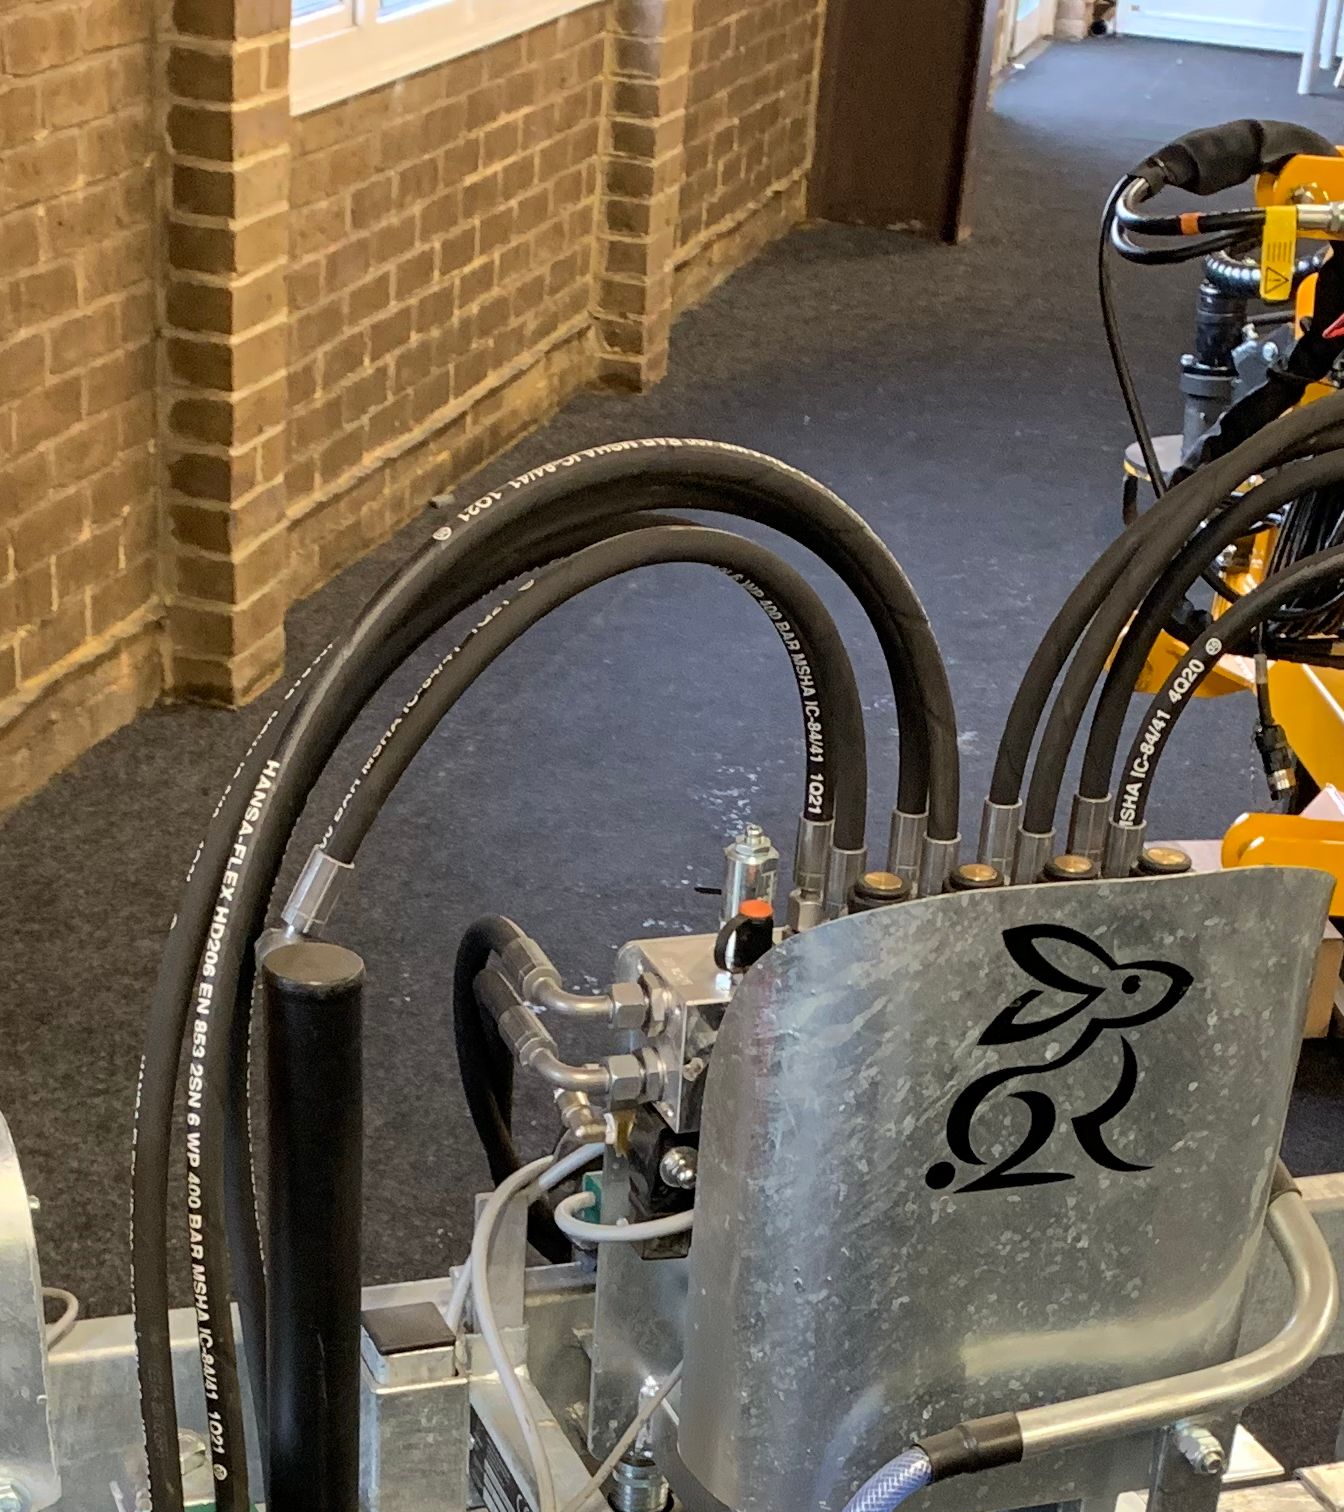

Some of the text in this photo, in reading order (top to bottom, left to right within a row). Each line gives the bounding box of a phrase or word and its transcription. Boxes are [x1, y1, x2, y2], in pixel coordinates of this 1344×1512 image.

[457, 491, 502, 522] 1Q21
[759, 598, 783, 621] 400
[775, 619, 801, 652] BAR
[790, 650, 816, 698] MSHA
[803, 700, 825, 763] IC-84/41
[1129, 708, 1172, 779] IC-84/41
[1167, 658, 1206, 705] 4Q20
[807, 772, 825, 816] 1Q21
[219, 758, 282, 903] HANSA-FLEX
[201, 905, 230, 978] HD206
[197, 981, 214, 1015] EN
[192, 1018, 209, 1059] 853
[187, 1062, 205, 1110] 2SN
[186, 1112, 202, 1128] 6
[186, 1131, 202, 1168] WP
[186, 1171, 202, 1209] 400
[188, 1213, 205, 1260] BAR
[191, 1263, 211, 1324] MSHA
[197, 1325, 220, 1402] IC-84/41
[207, 1410, 227, 1456] 1Q21
